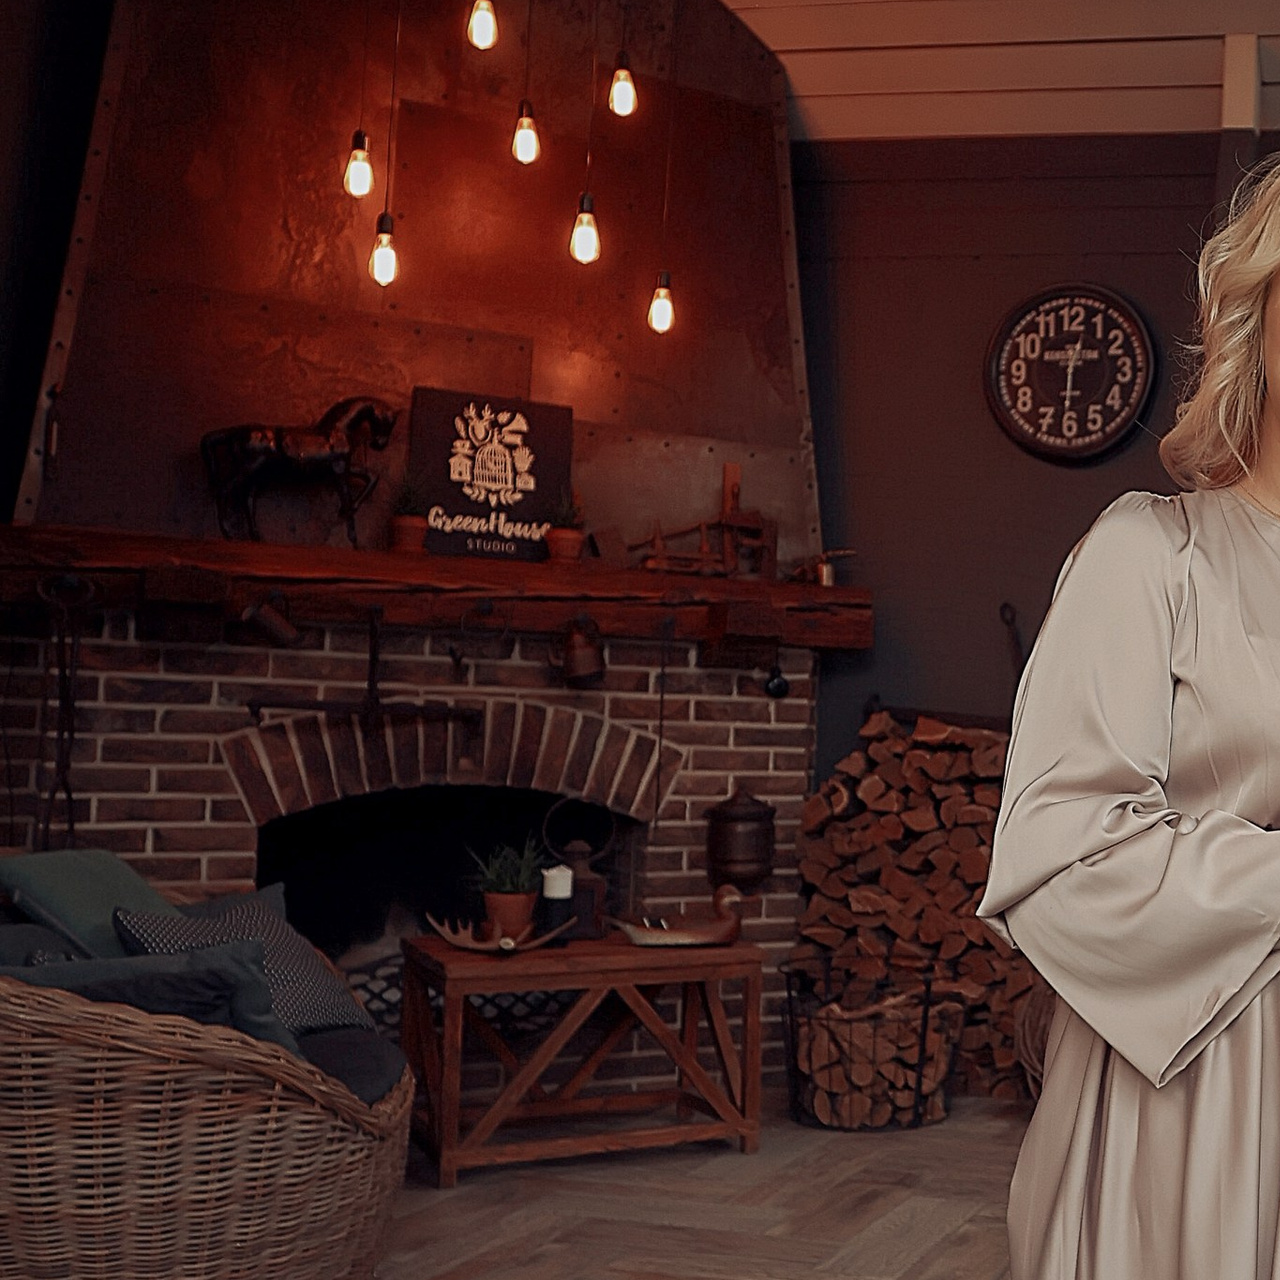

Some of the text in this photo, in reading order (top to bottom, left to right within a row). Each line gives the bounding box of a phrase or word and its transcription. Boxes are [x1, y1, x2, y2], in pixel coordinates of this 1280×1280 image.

[1036, 312, 1057, 338] 11
[1059, 306, 1085, 331] 12
[1092, 313, 1104, 339] 1
[1015, 333, 1041, 359] 10
[1108, 329, 1124, 356] 2
[1010, 359, 1026, 385] 9
[1116, 356, 1133, 383] 3
[1016, 386, 1033, 413] 8
[1106, 384, 1122, 411] 4
[1038, 406, 1056, 432] 7
[1062, 411, 1078, 438] 6
[1086, 404, 1103, 431] 5
[466, 538, 515, 554] STUDIO
